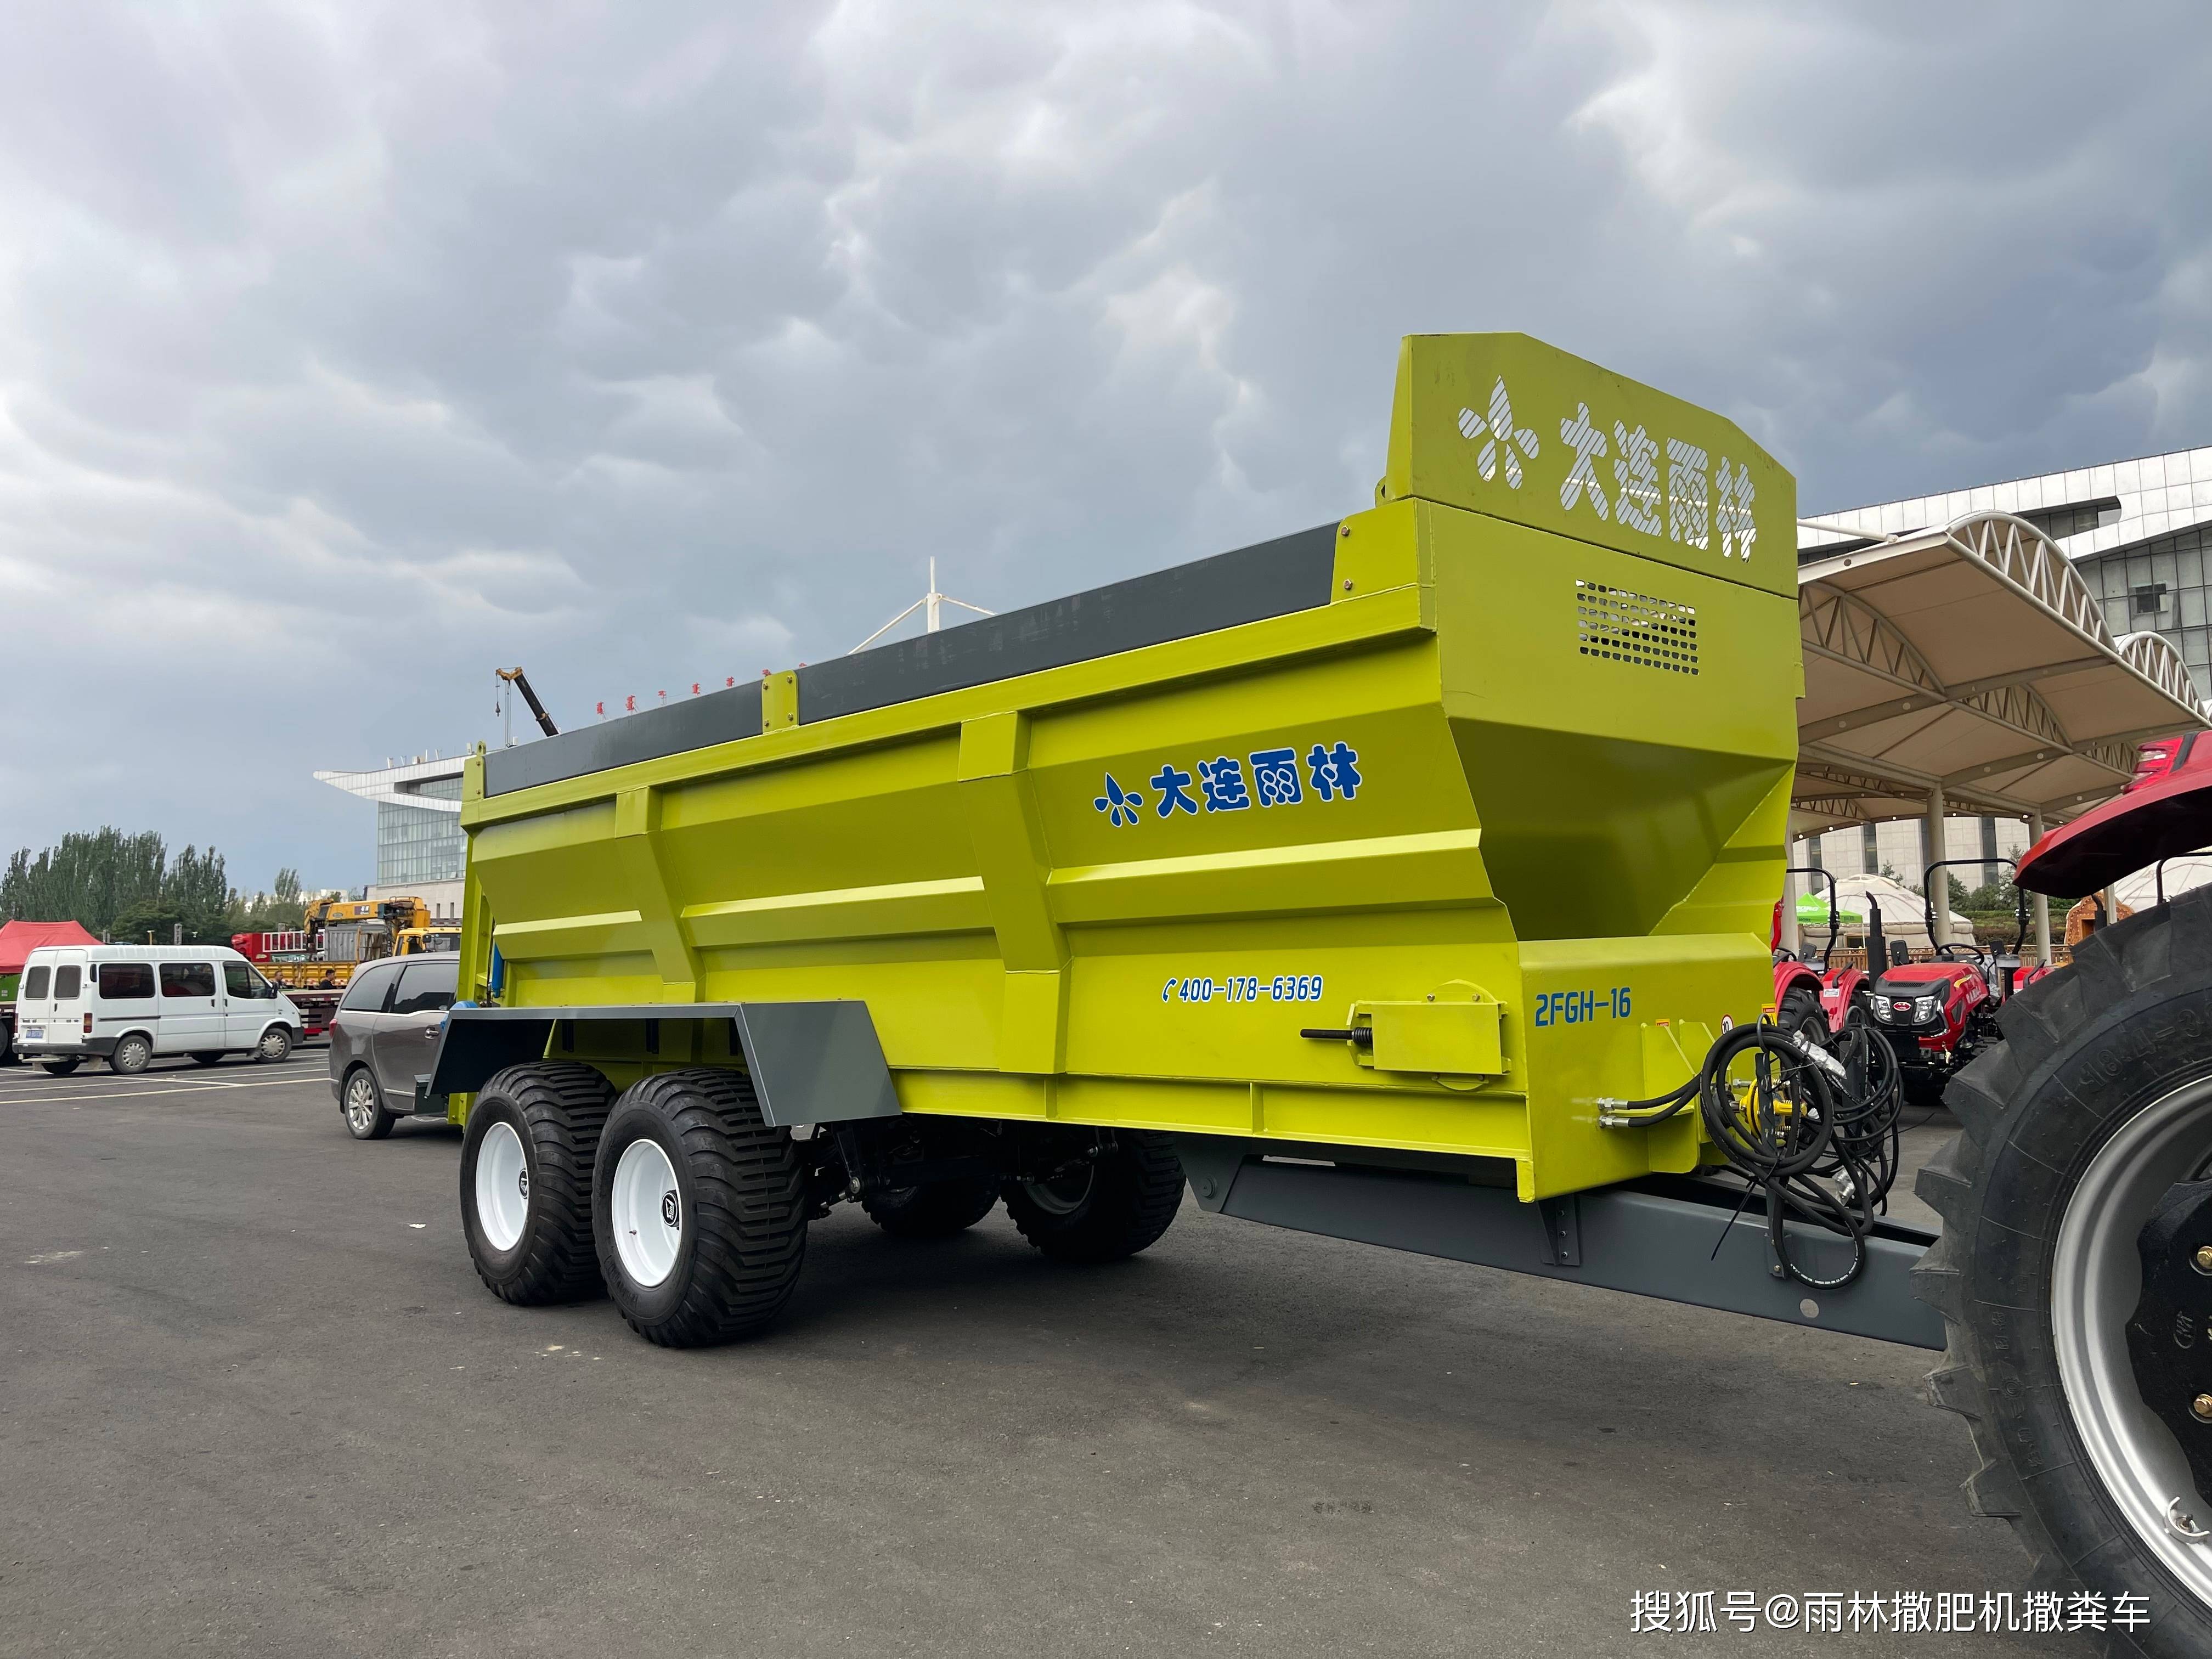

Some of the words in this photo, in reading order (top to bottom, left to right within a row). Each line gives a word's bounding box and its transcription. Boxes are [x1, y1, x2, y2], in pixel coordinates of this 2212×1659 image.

[1559, 402, 1757, 563] 大连雨林
[1150, 741, 1362, 819] 大连雨林
[1179, 975, 1323, 1002] 400-178-6369
[1535, 987, 1631, 1027] 2FGH-16
[2079, 1002, 2212, 1087] 18.4-3
